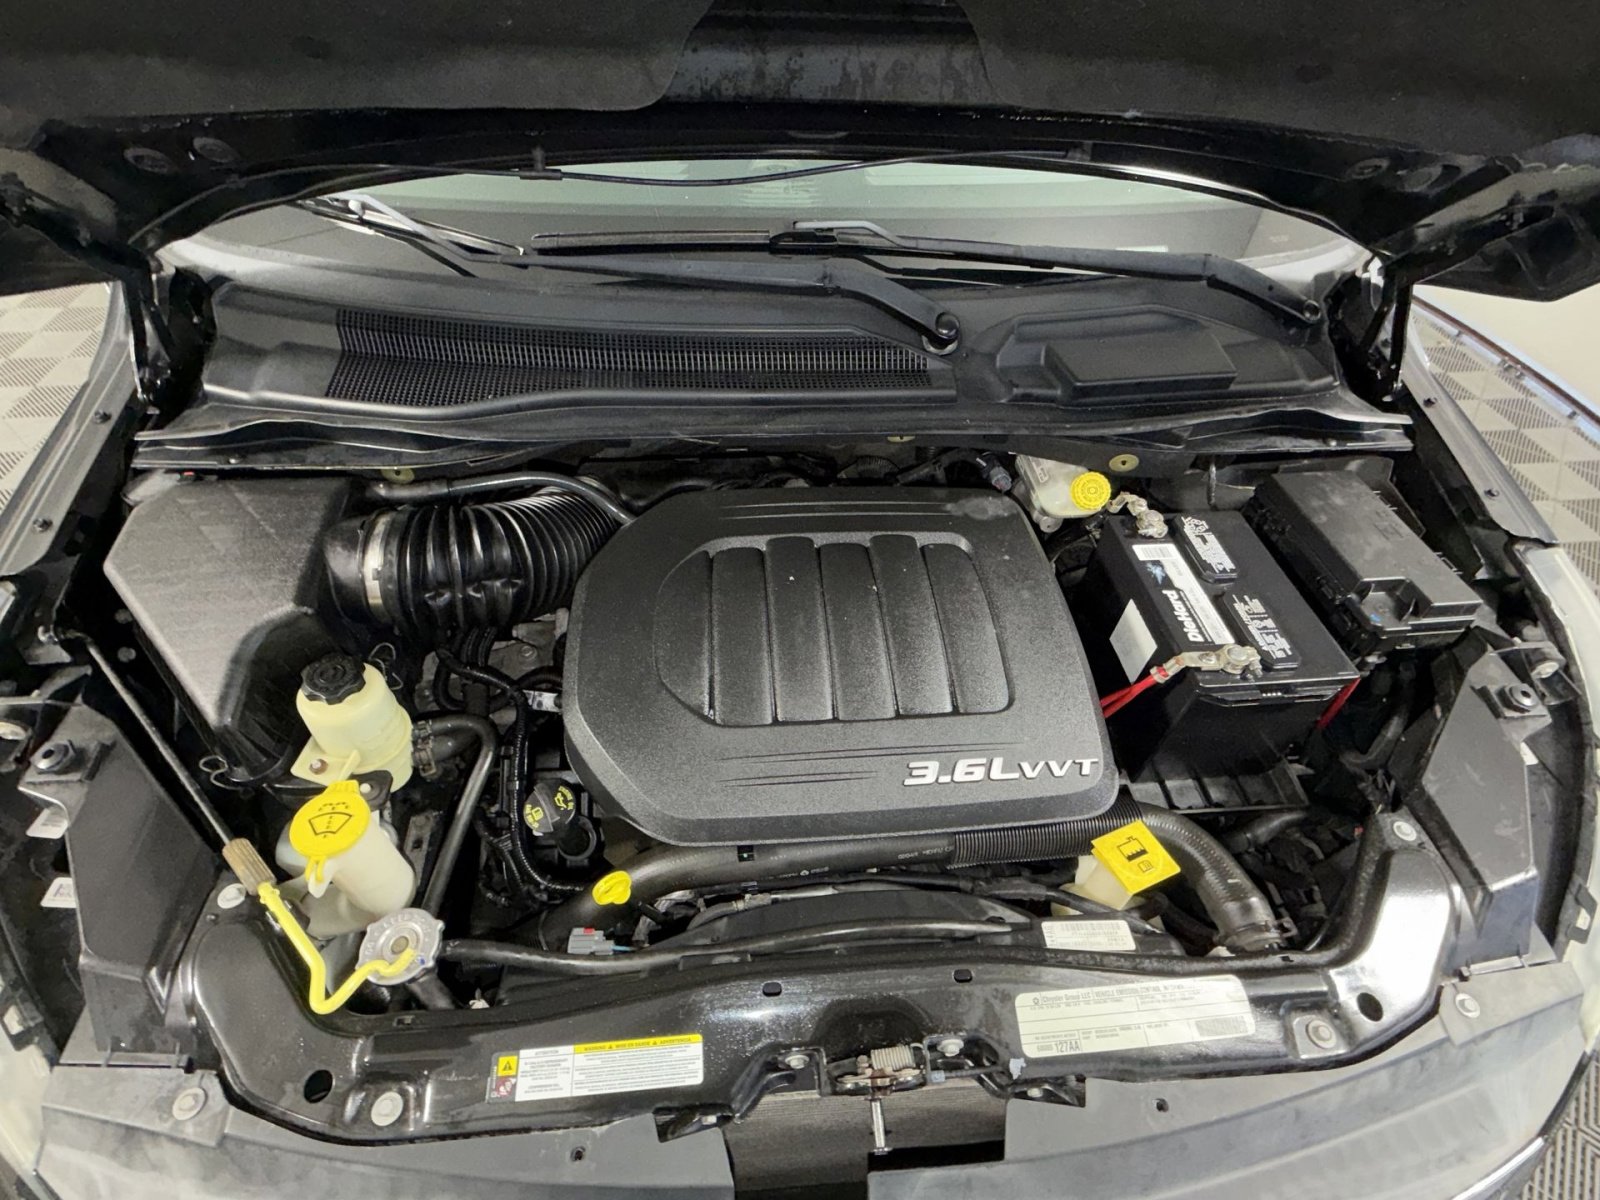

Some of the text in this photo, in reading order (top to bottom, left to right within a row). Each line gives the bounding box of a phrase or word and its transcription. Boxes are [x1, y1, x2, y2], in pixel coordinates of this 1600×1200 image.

[1161, 589, 1205, 642] DieHard
[1080, 991, 1091, 1000] LLC
[1055, 1040, 1080, 1053] 127AA
